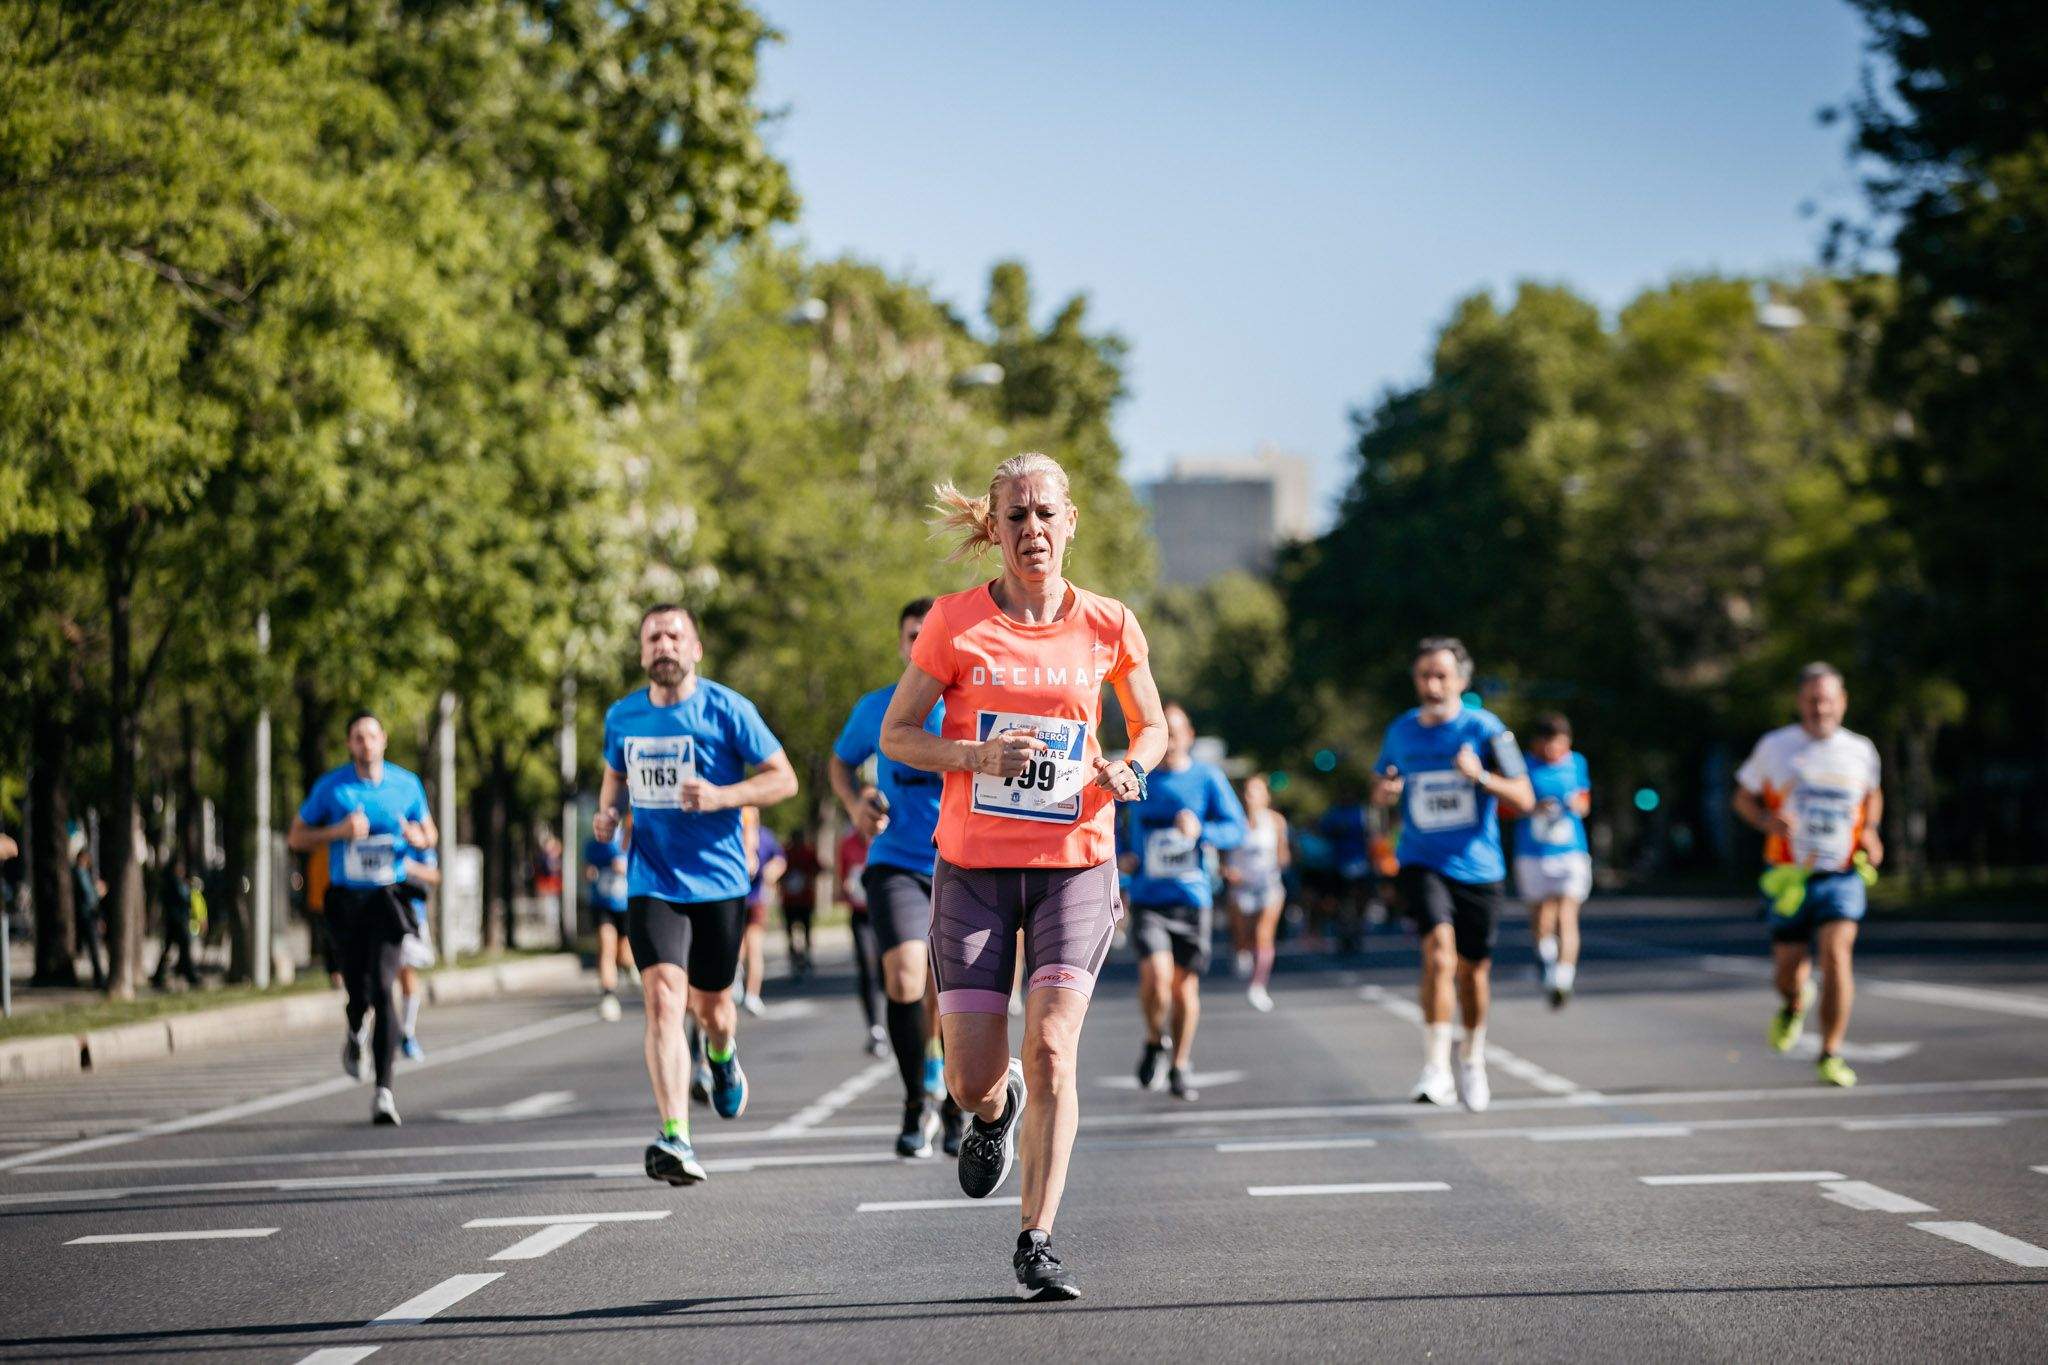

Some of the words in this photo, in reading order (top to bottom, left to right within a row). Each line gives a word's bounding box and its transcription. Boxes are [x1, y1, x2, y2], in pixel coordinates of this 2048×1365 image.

[1035, 731, 1067, 742] BEROS
[1034, 749, 1065, 760] IMAS
[641, 768, 677, 787] 1763
